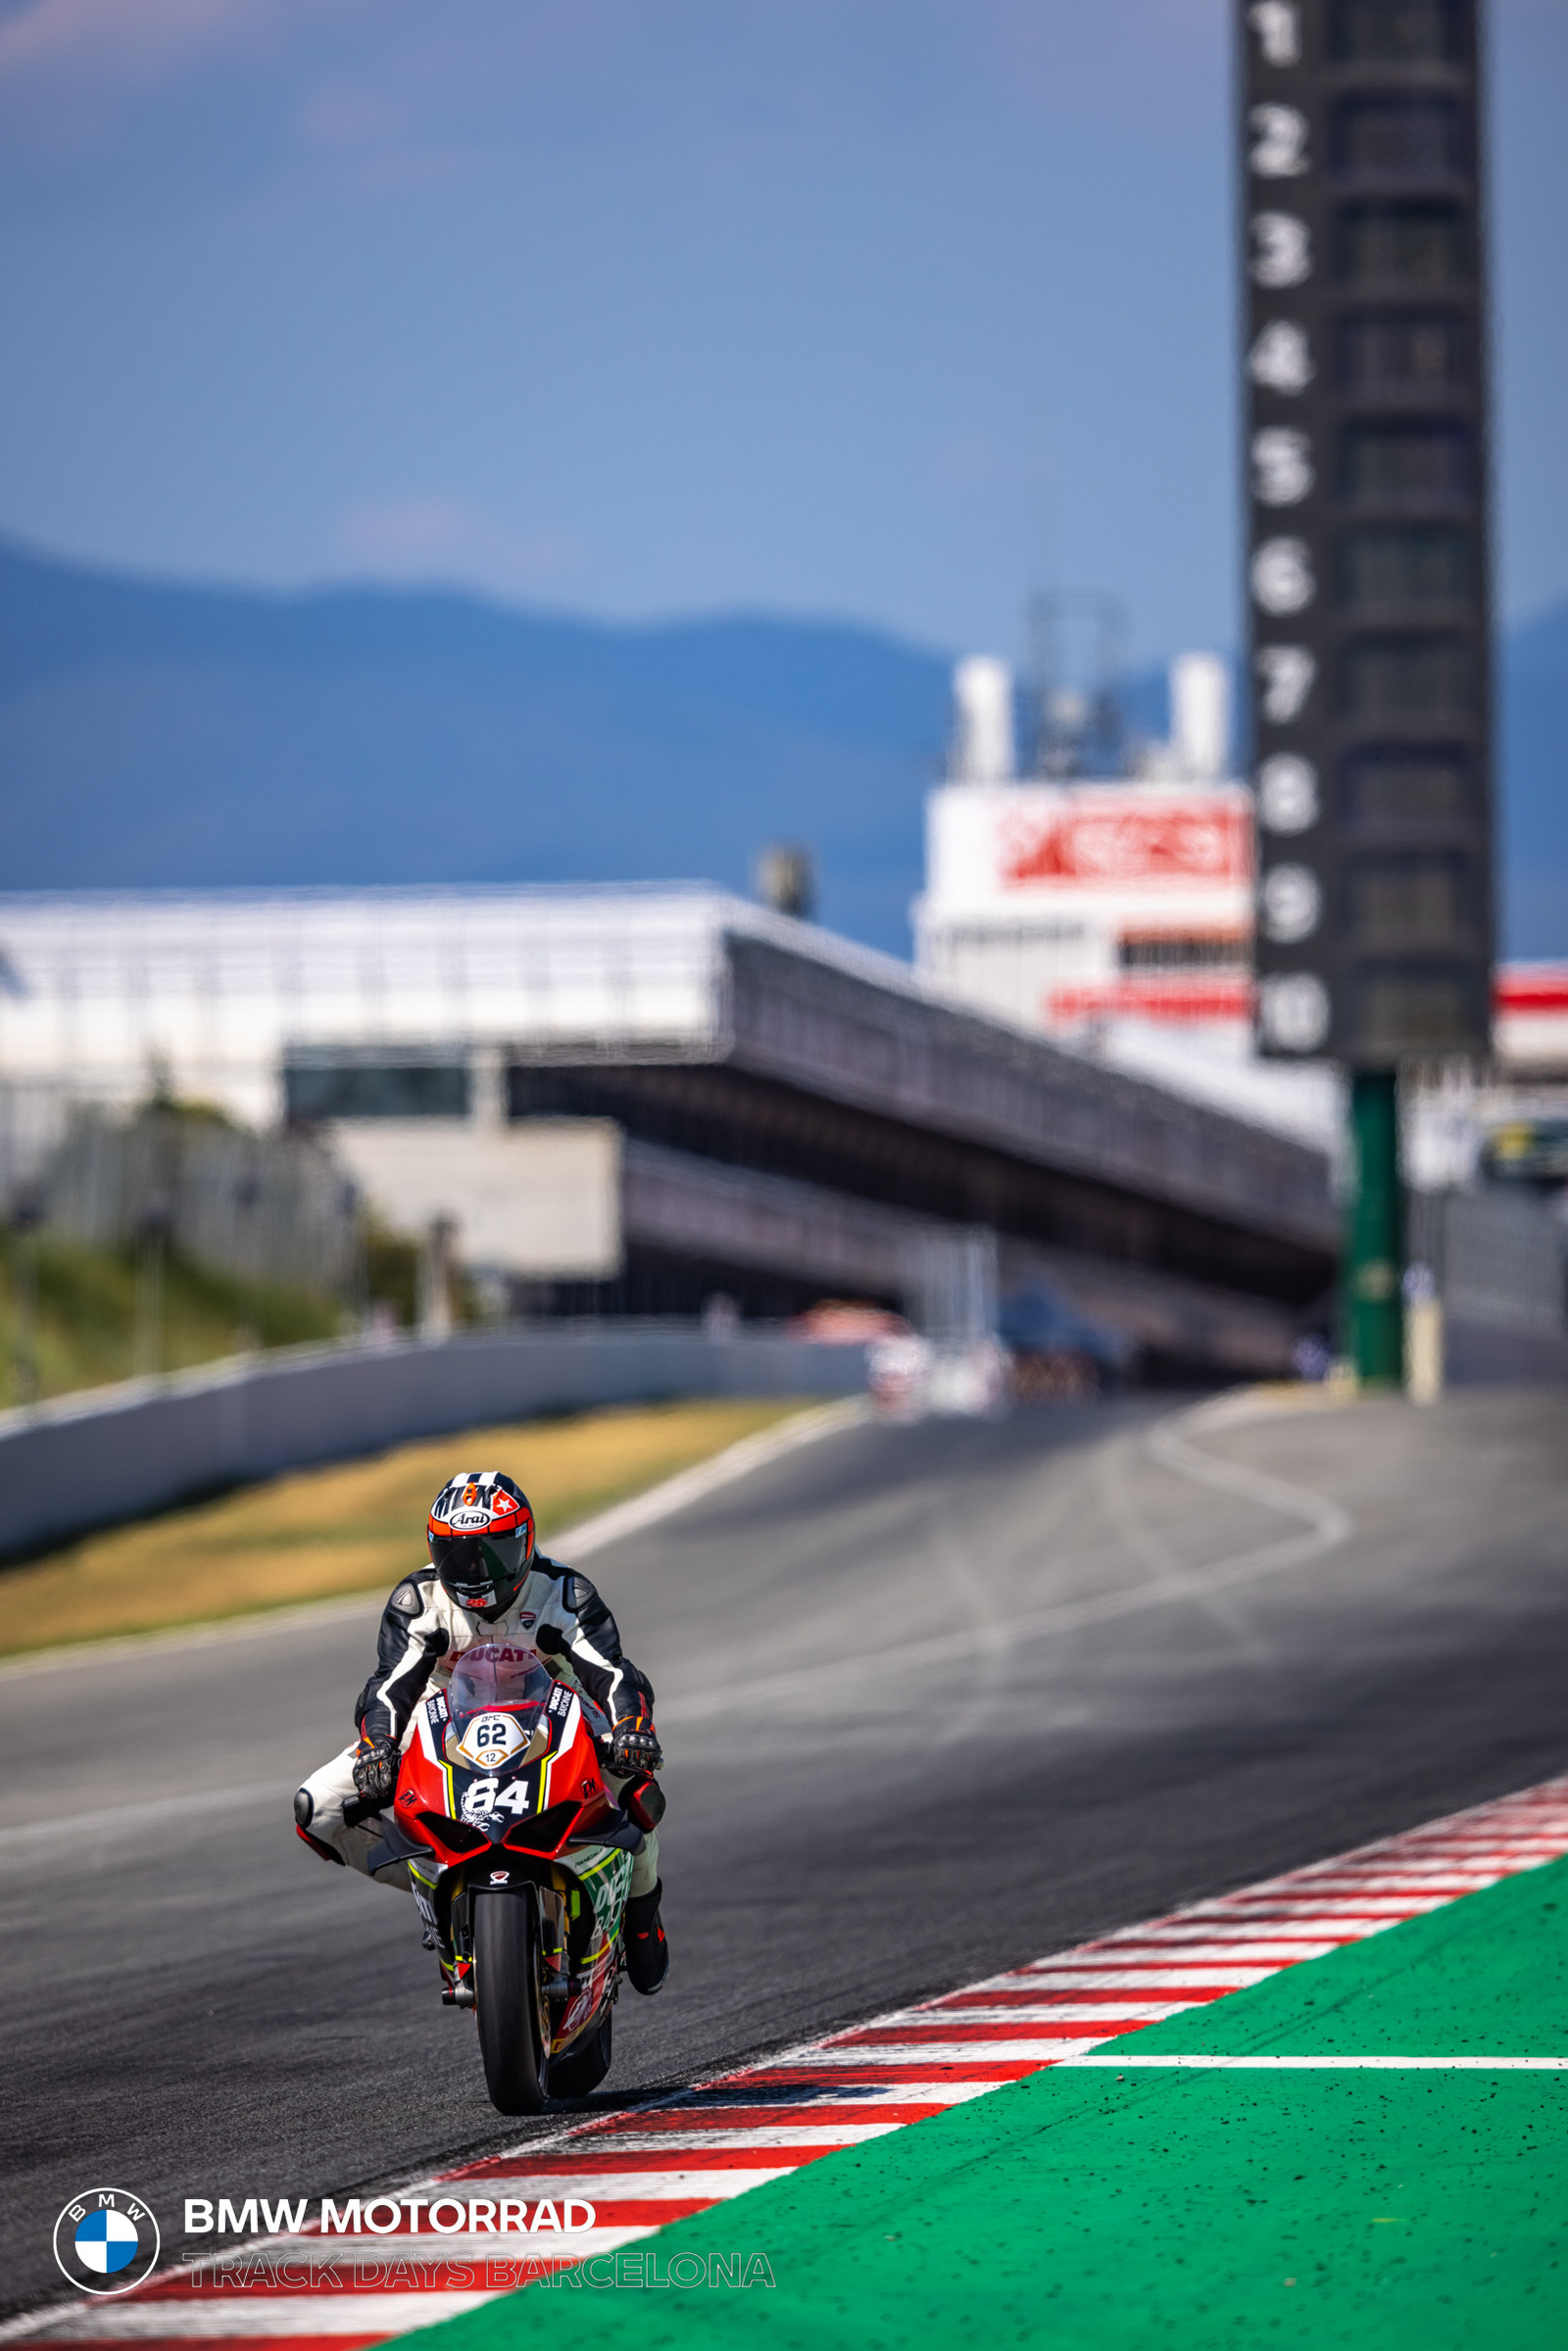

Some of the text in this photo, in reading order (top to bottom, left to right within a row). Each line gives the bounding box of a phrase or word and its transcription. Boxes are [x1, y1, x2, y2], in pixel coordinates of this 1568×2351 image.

[1251, 0, 1299, 65] 1
[1250, 105, 1309, 177] 2
[1250, 212, 1311, 288] 3
[1249, 320, 1313, 394] 4
[1251, 427, 1314, 507] 5
[1250, 536, 1315, 615] 6
[1257, 645, 1315, 723] 7
[1259, 753, 1318, 834] 8
[1263, 863, 1320, 944] 9
[453, 1513, 485, 1526] Arai
[450, 1648, 537, 1663] DUCATI
[436, 1695, 449, 1719] DUCATI
[548, 1687, 564, 1711] DUCATI
[476, 1723, 507, 1748] 62
[485, 1752, 497, 1763] 12
